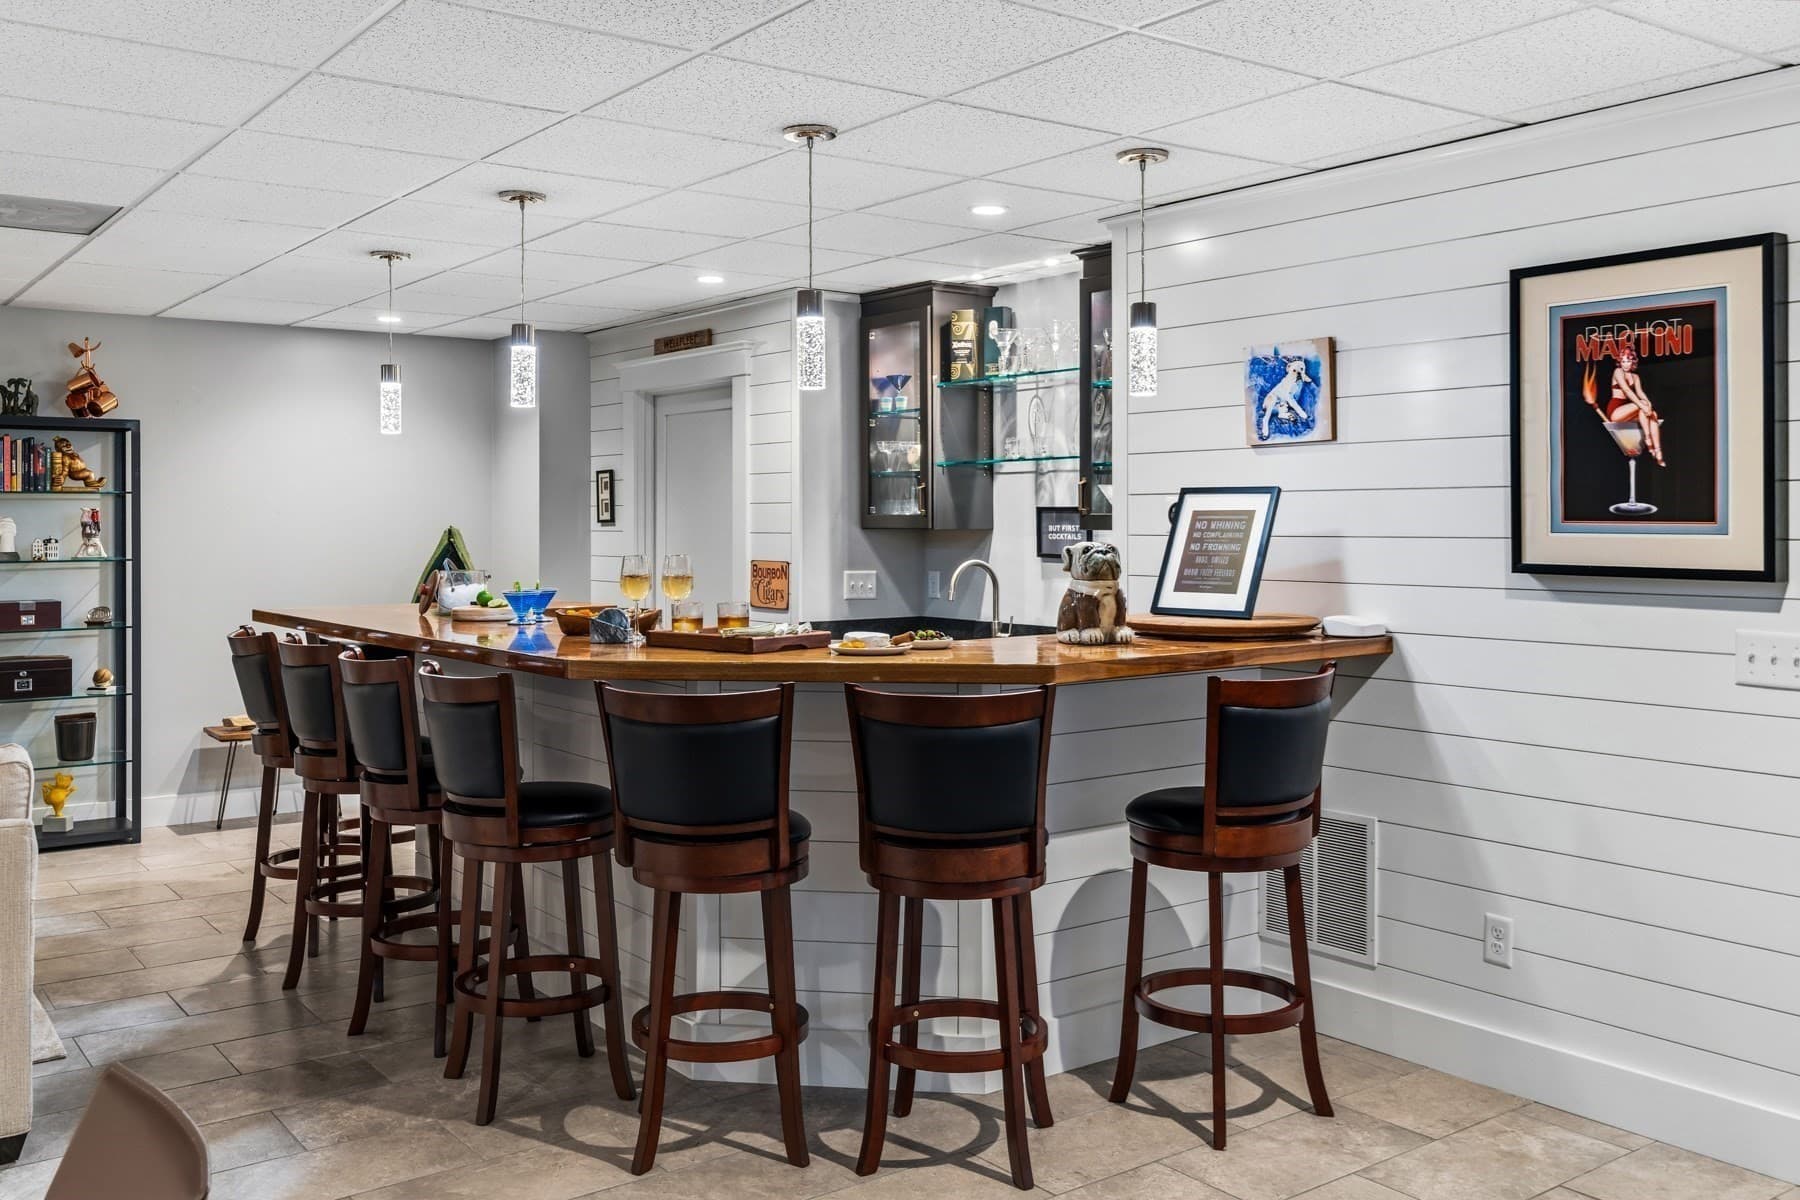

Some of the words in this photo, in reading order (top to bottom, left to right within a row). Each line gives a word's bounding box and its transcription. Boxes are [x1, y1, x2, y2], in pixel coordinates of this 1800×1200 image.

[1585, 323, 1630, 342] RED
[1634, 318, 1683, 339] HOT
[1576, 324, 1693, 363] MARTINI
[1048, 524, 1060, 532] BUT
[1061, 524, 1080, 532] FIRST
[1195, 521, 1208, 530] NO
[1210, 521, 1247, 530] WHINING
[1190, 543, 1200, 551] NO
[1202, 543, 1242, 552] FROWNING
[752, 578, 785, 606] Cigars
